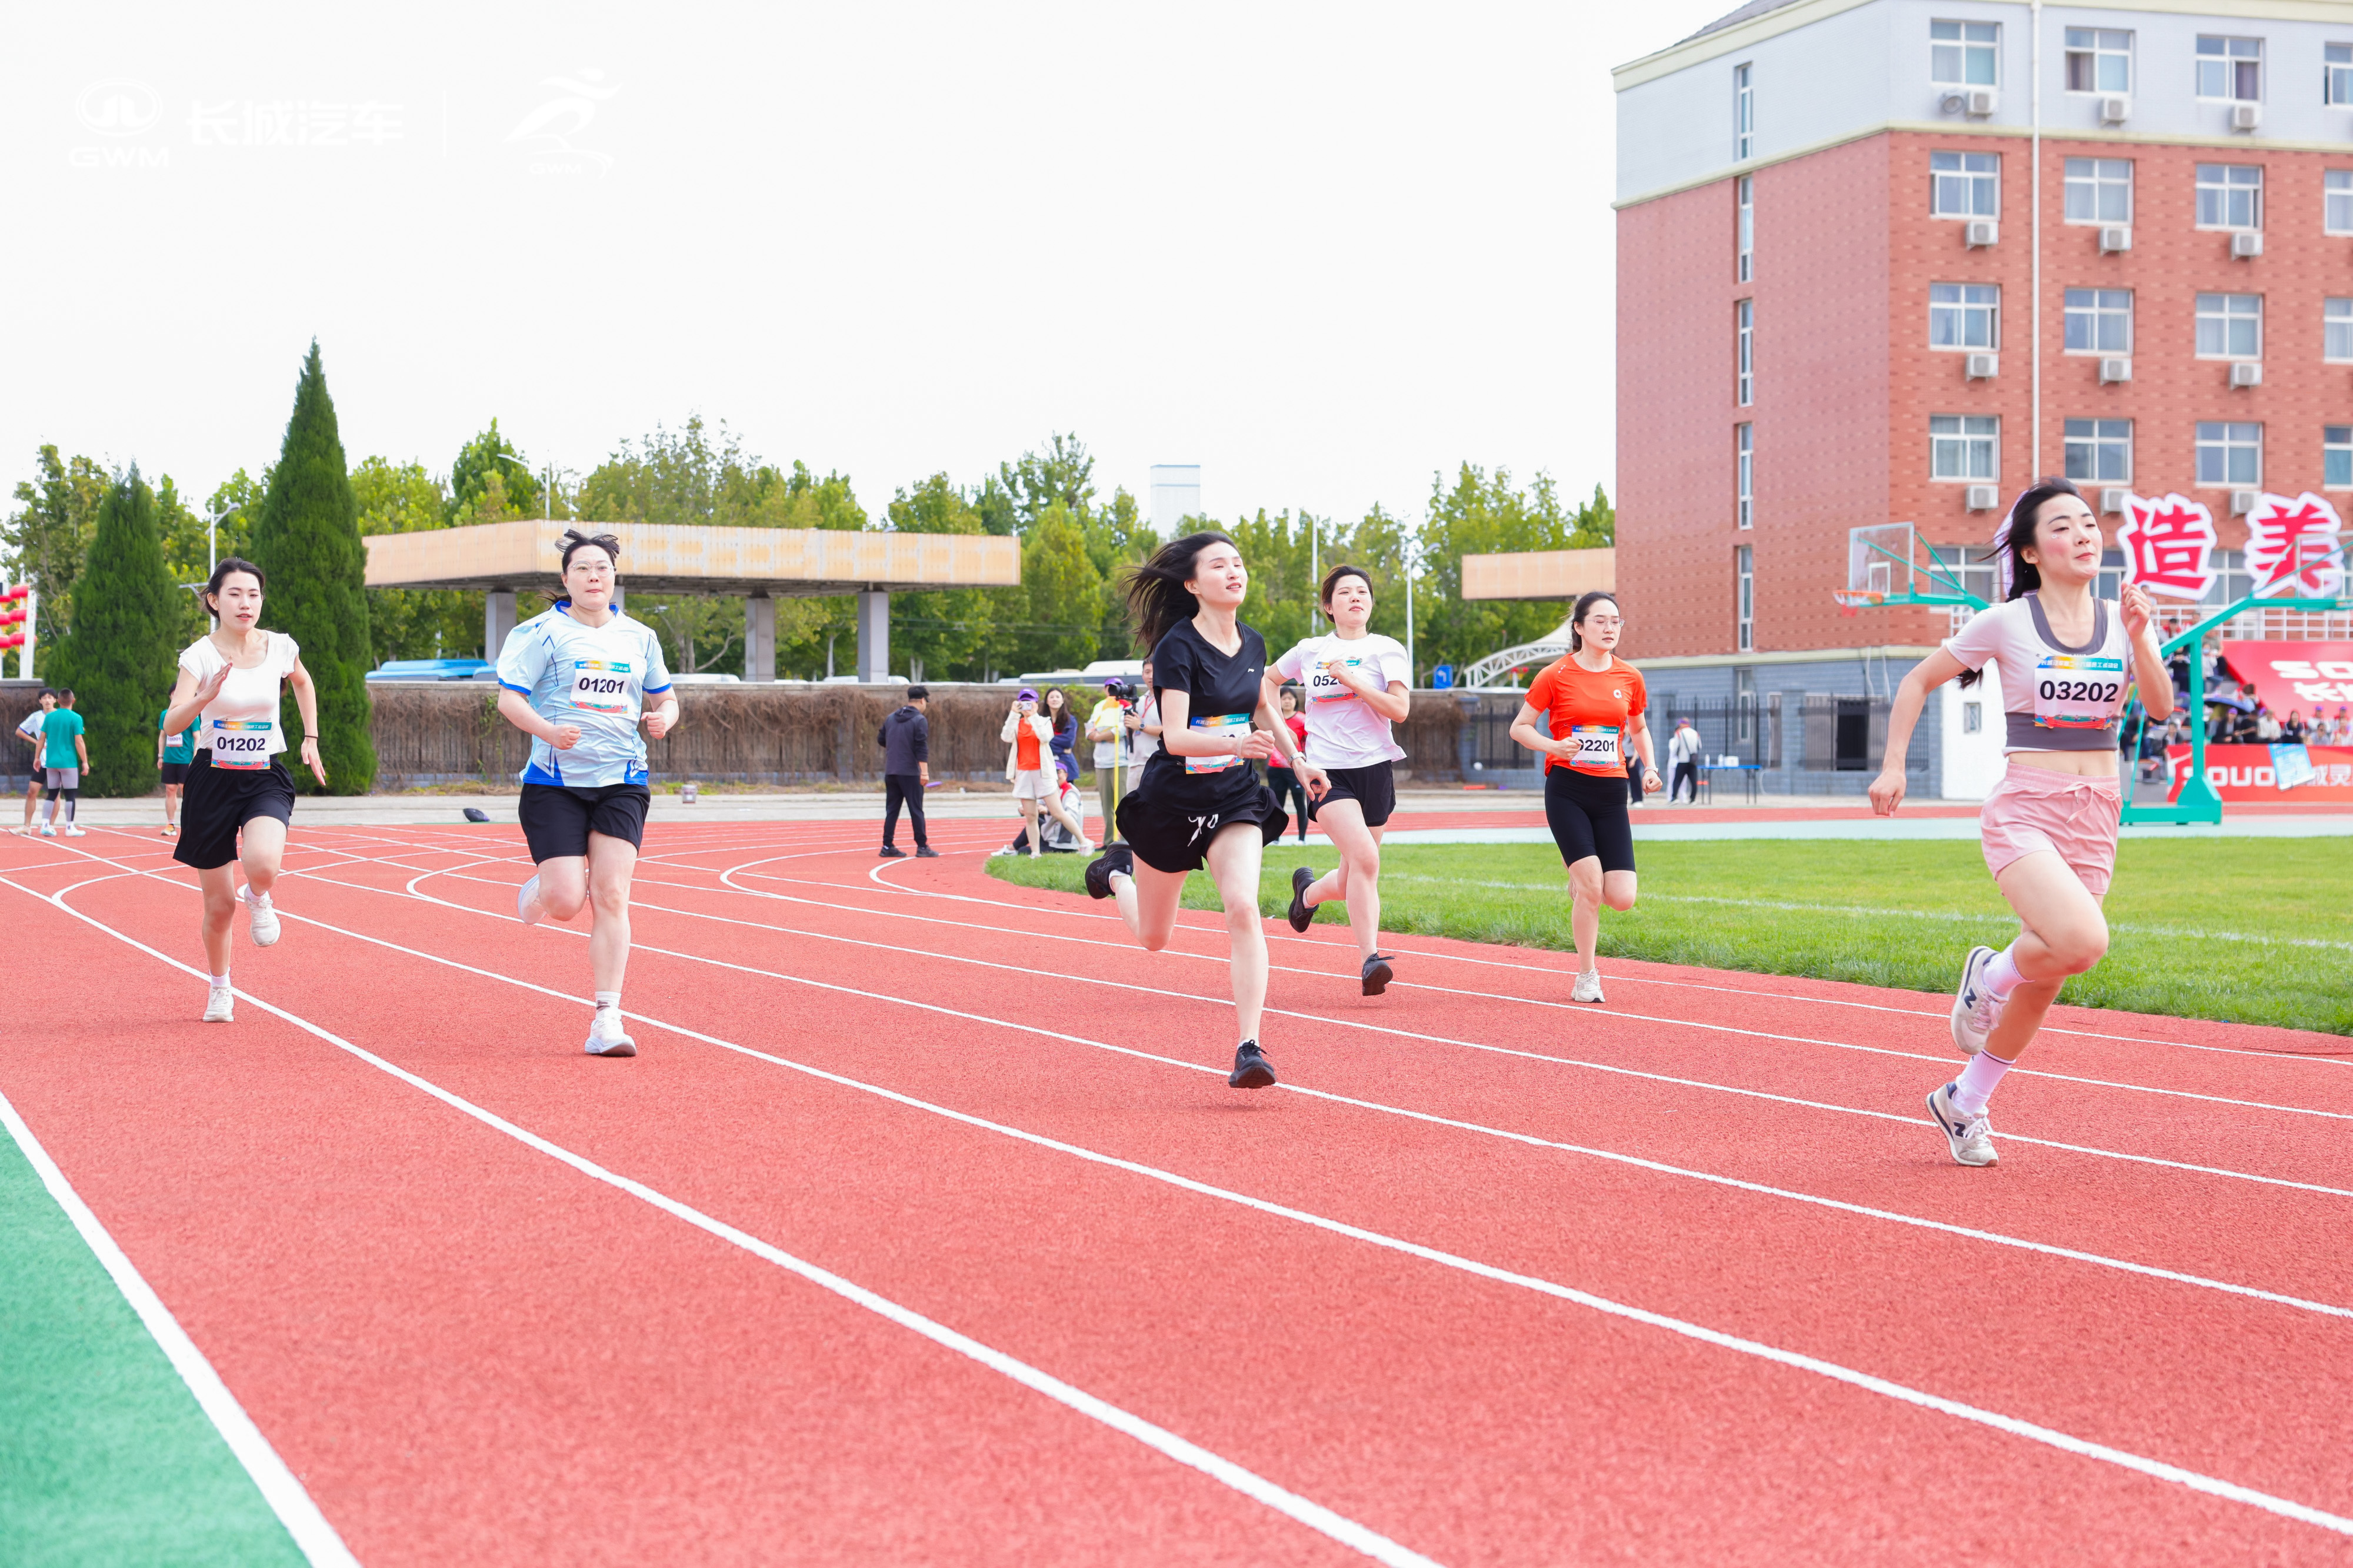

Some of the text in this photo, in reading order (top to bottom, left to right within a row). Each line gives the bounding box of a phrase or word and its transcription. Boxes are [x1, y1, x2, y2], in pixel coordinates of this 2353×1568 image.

[579, 677, 625, 694] 01201
[2039, 680, 2118, 702] 03202
[216, 736, 266, 752] 01202
